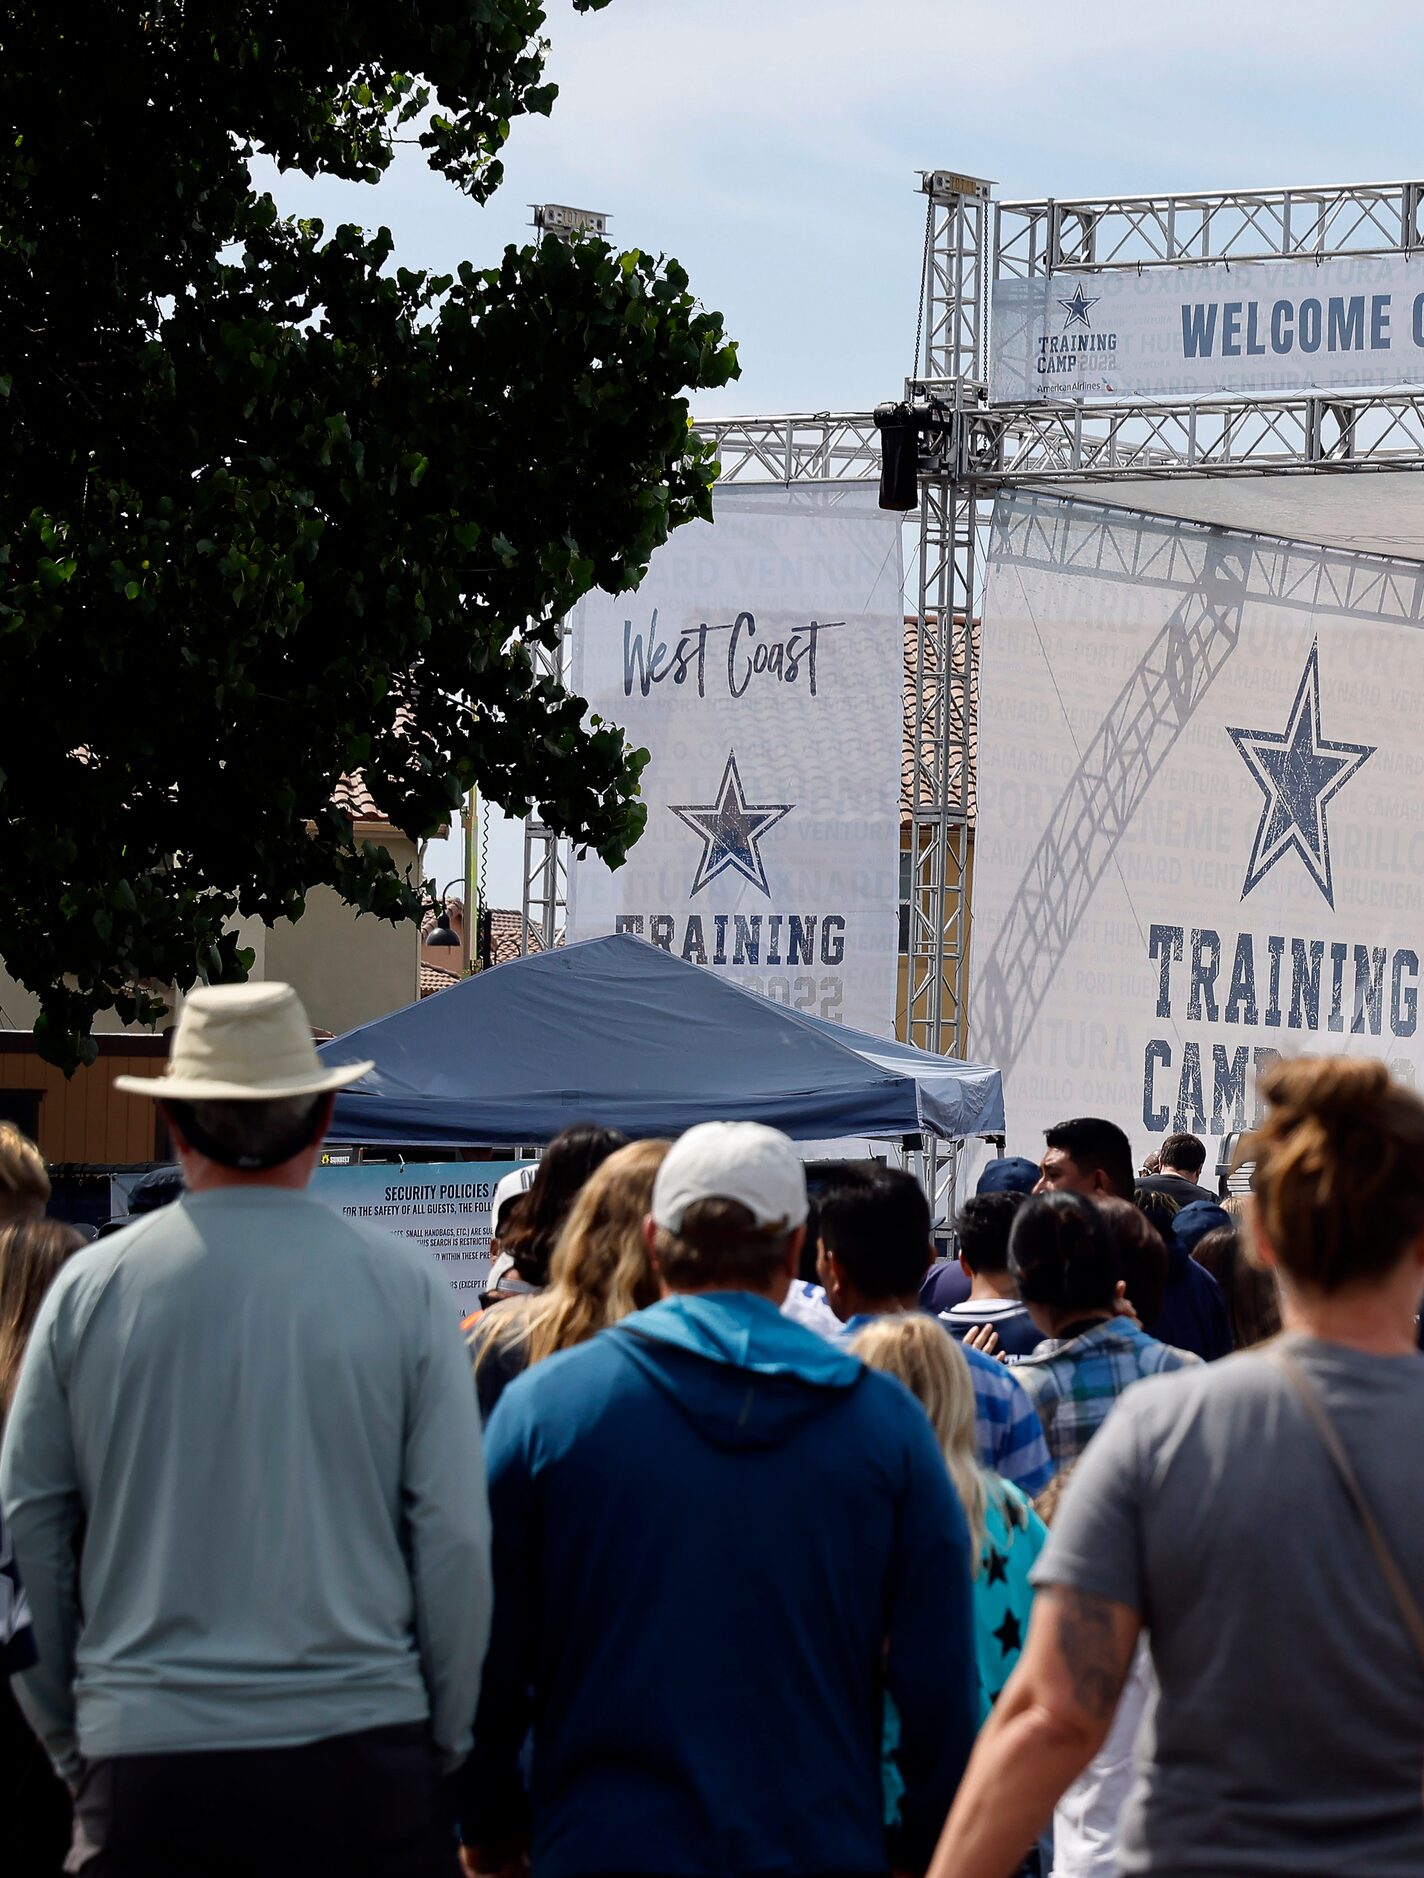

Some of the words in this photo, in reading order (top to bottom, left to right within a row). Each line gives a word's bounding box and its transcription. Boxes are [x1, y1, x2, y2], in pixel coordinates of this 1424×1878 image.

[1181, 294, 1391, 358] WELCOME
[1039, 334, 1117, 354] TRAINING
[1037, 355, 1077, 374] CAMP
[1078, 354, 1117, 371] 2022
[623, 608, 733, 698] West
[727, 611, 846, 698] Coast
[1149, 924, 1419, 1038] TRAINING
[385, 1185, 436, 1201] SECURITY
[441, 1183, 489, 1199] POLICIES
[343, 1206, 356, 1217] FOR
[359, 1206, 372, 1217] THE
[374, 1205, 400, 1216] SAFETY
[401, 1204, 411, 1215] OF
[413, 1204, 425, 1214] ALL
[427, 1203, 457, 1214] GUESTS,
[459, 1202, 472, 1213] THE
[406, 1229, 423, 1238] SMALL
[425, 1228, 455, 1238] HANDBAGS,
[471, 1227, 481, 1236] ARE
[430, 1238, 452, 1247] SEARCH
[453, 1237, 459, 1246] IS
[442, 1252, 460, 1261] WITHIN
[462, 1251, 479, 1260] THESE
[459, 1280, 480, 1290] (EXCEPT
